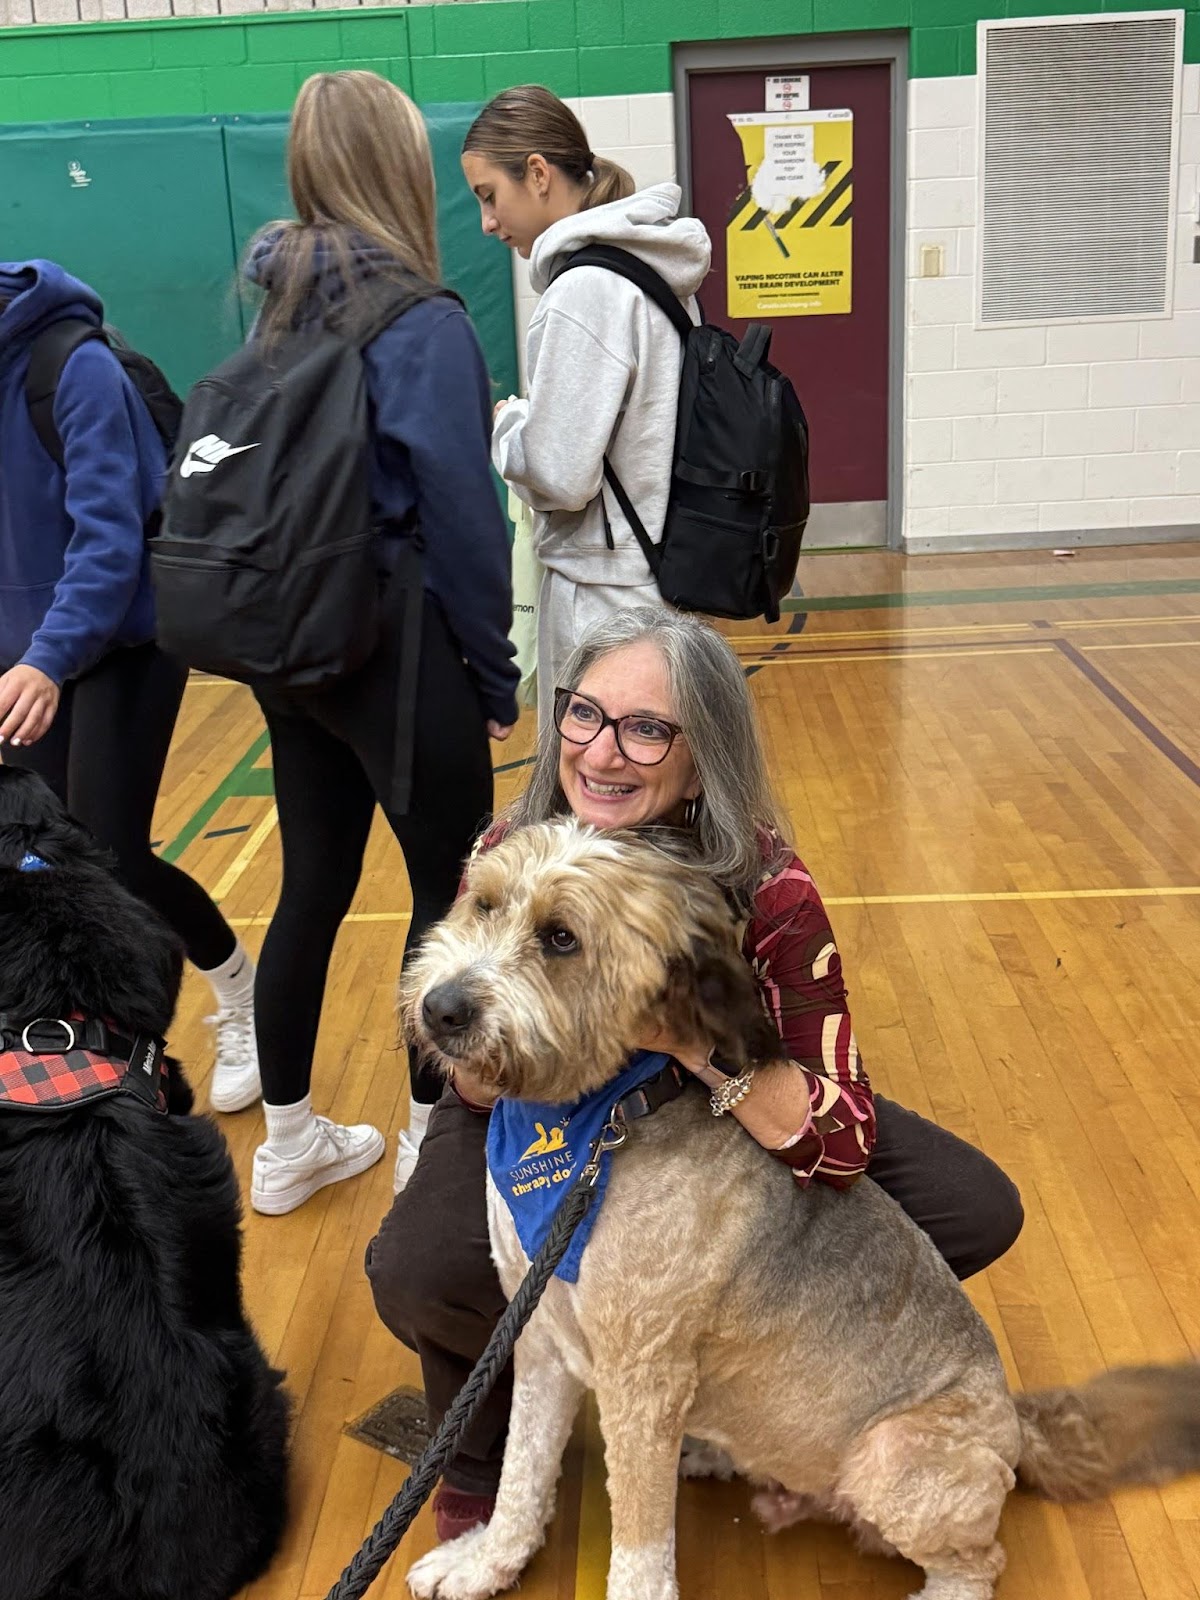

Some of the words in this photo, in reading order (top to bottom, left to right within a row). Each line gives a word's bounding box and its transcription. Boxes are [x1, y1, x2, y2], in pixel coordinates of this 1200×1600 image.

[765, 272, 801, 281] NICOTINE
[802, 271, 819, 279] CAN
[820, 270, 844, 278] ALTER
[738, 282, 758, 290] TEEN
[759, 281, 783, 289] BRAIN
[784, 279, 840, 288] DEVELOPMENT
[509, 1150, 574, 1182] SUNSHINE
